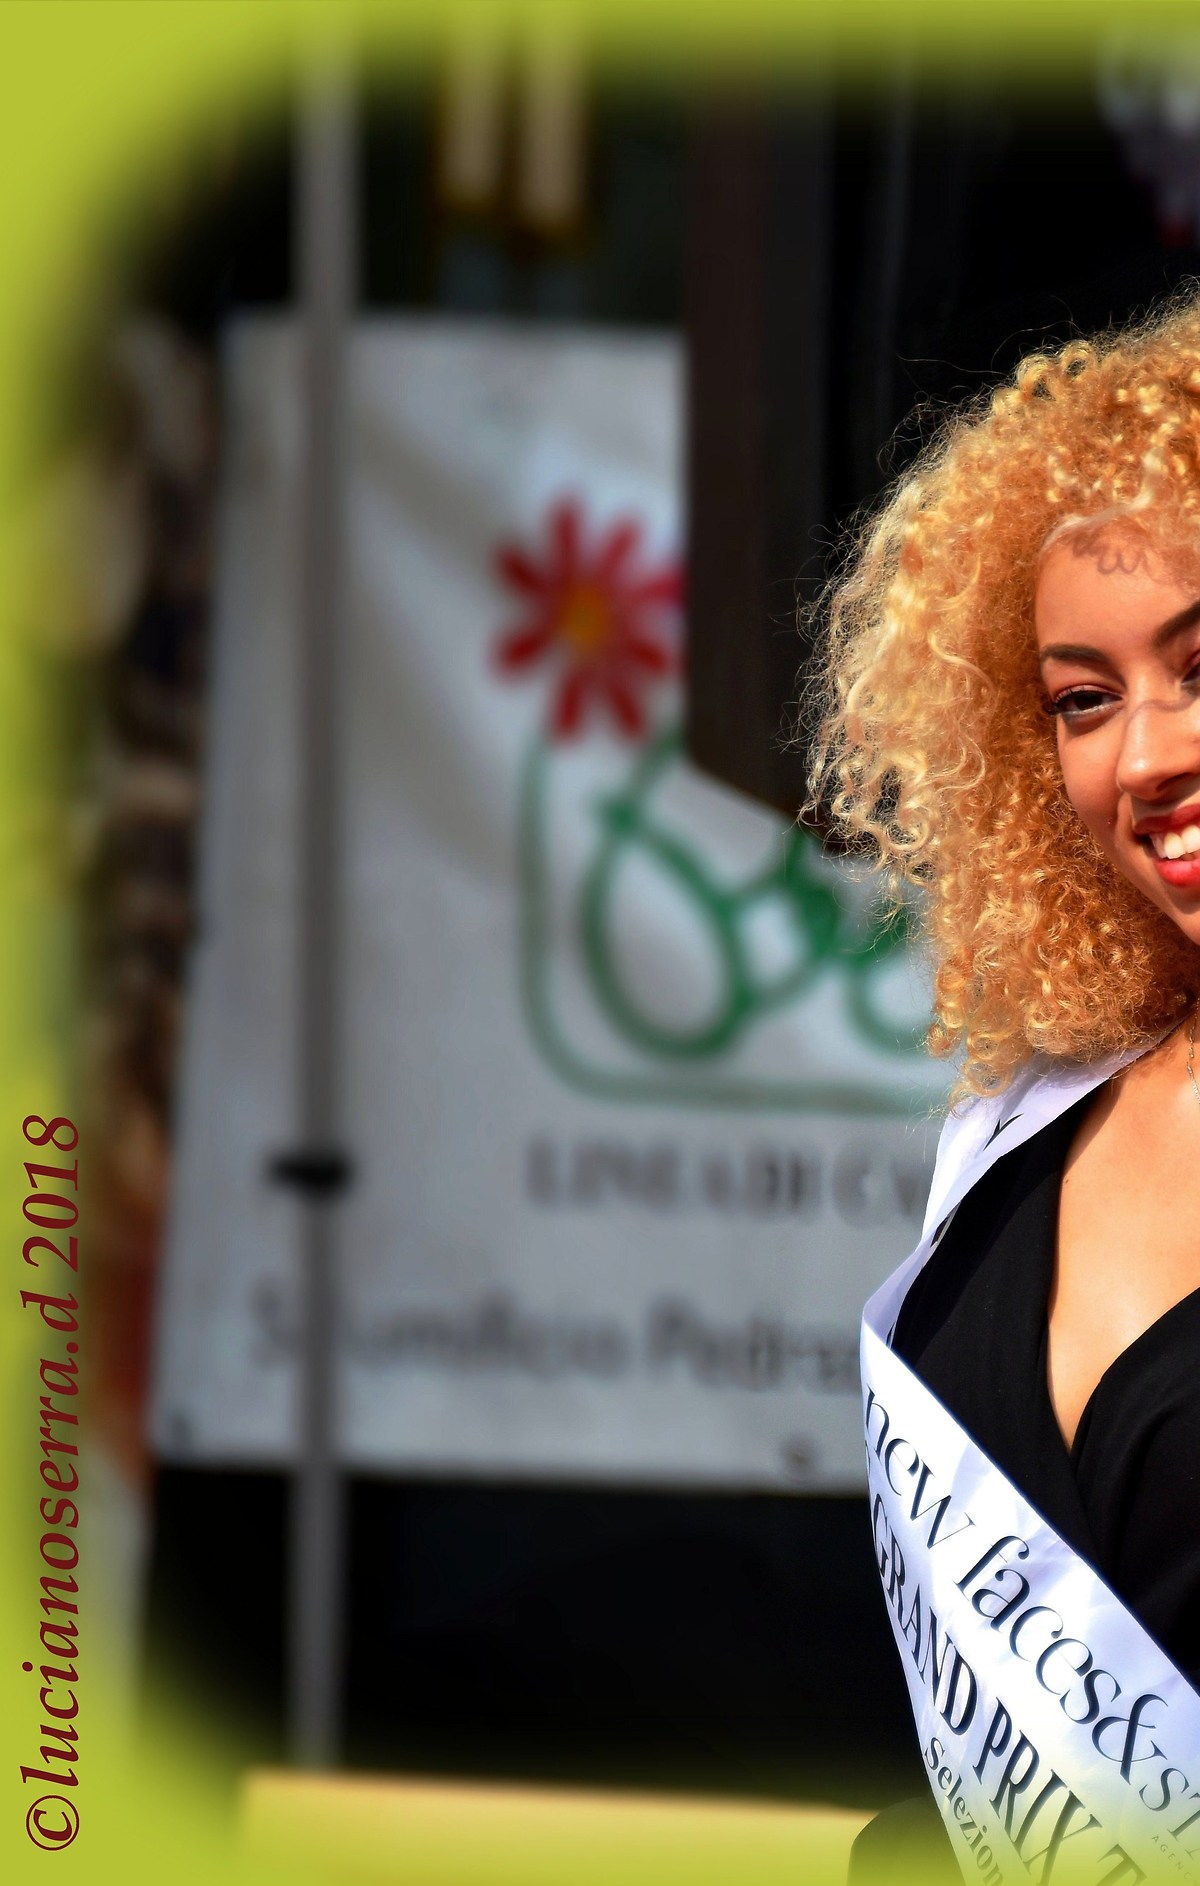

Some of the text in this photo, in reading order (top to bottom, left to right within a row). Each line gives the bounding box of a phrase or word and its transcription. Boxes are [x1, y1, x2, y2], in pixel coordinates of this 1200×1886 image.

[864, 1387, 977, 1550] new
[871, 1493, 978, 1737] GRAND
[972, 1696, 1104, 1886] PRIX
[1151, 1834, 1200, 1886] AGENC
